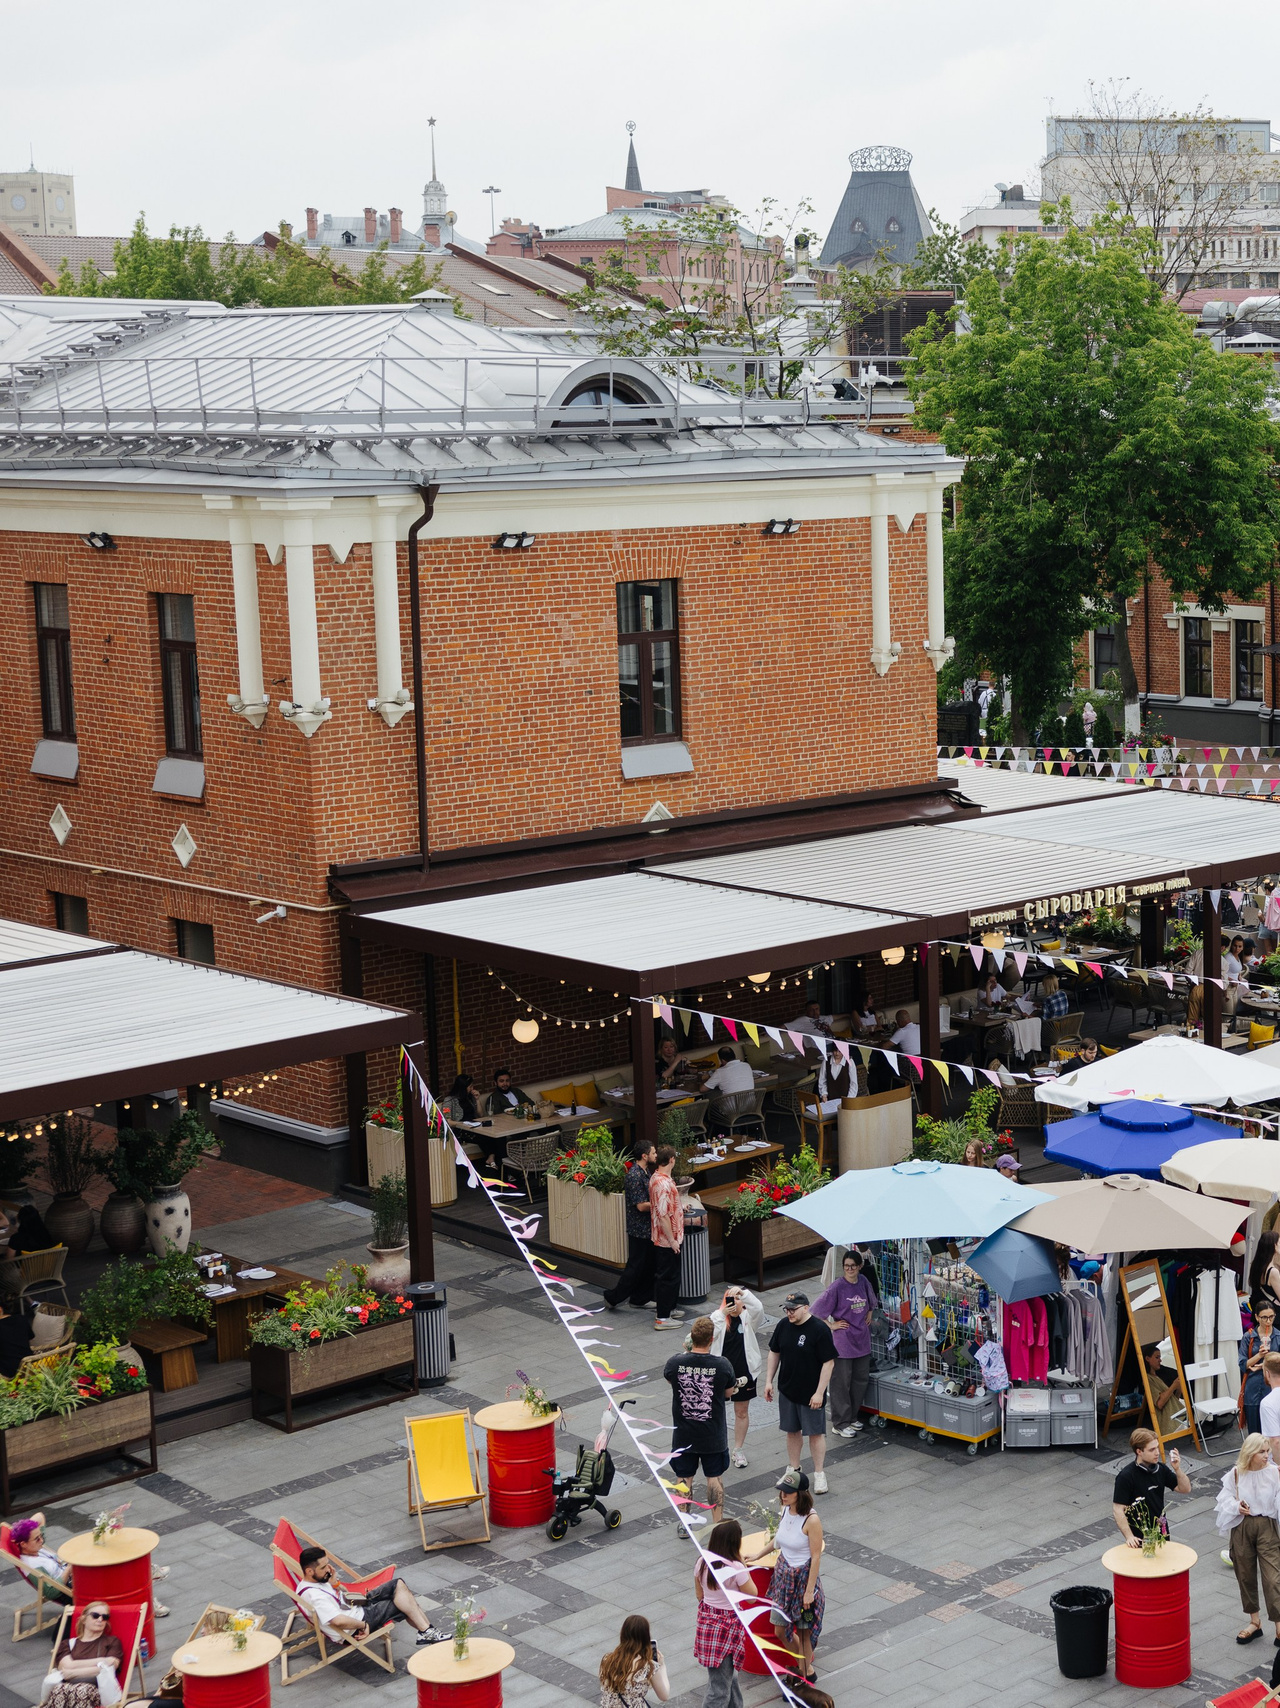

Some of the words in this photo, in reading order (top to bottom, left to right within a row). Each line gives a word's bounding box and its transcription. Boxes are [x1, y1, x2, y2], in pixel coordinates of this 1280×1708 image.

[970, 909, 1017, 927] РЕСТОРАН
[1023, 885, 1126, 921] СЫРОВАРНЯ
[1133, 882, 1164, 896] СЫРНАЯ
[1165, 877, 1191, 891] ЛАВКА
